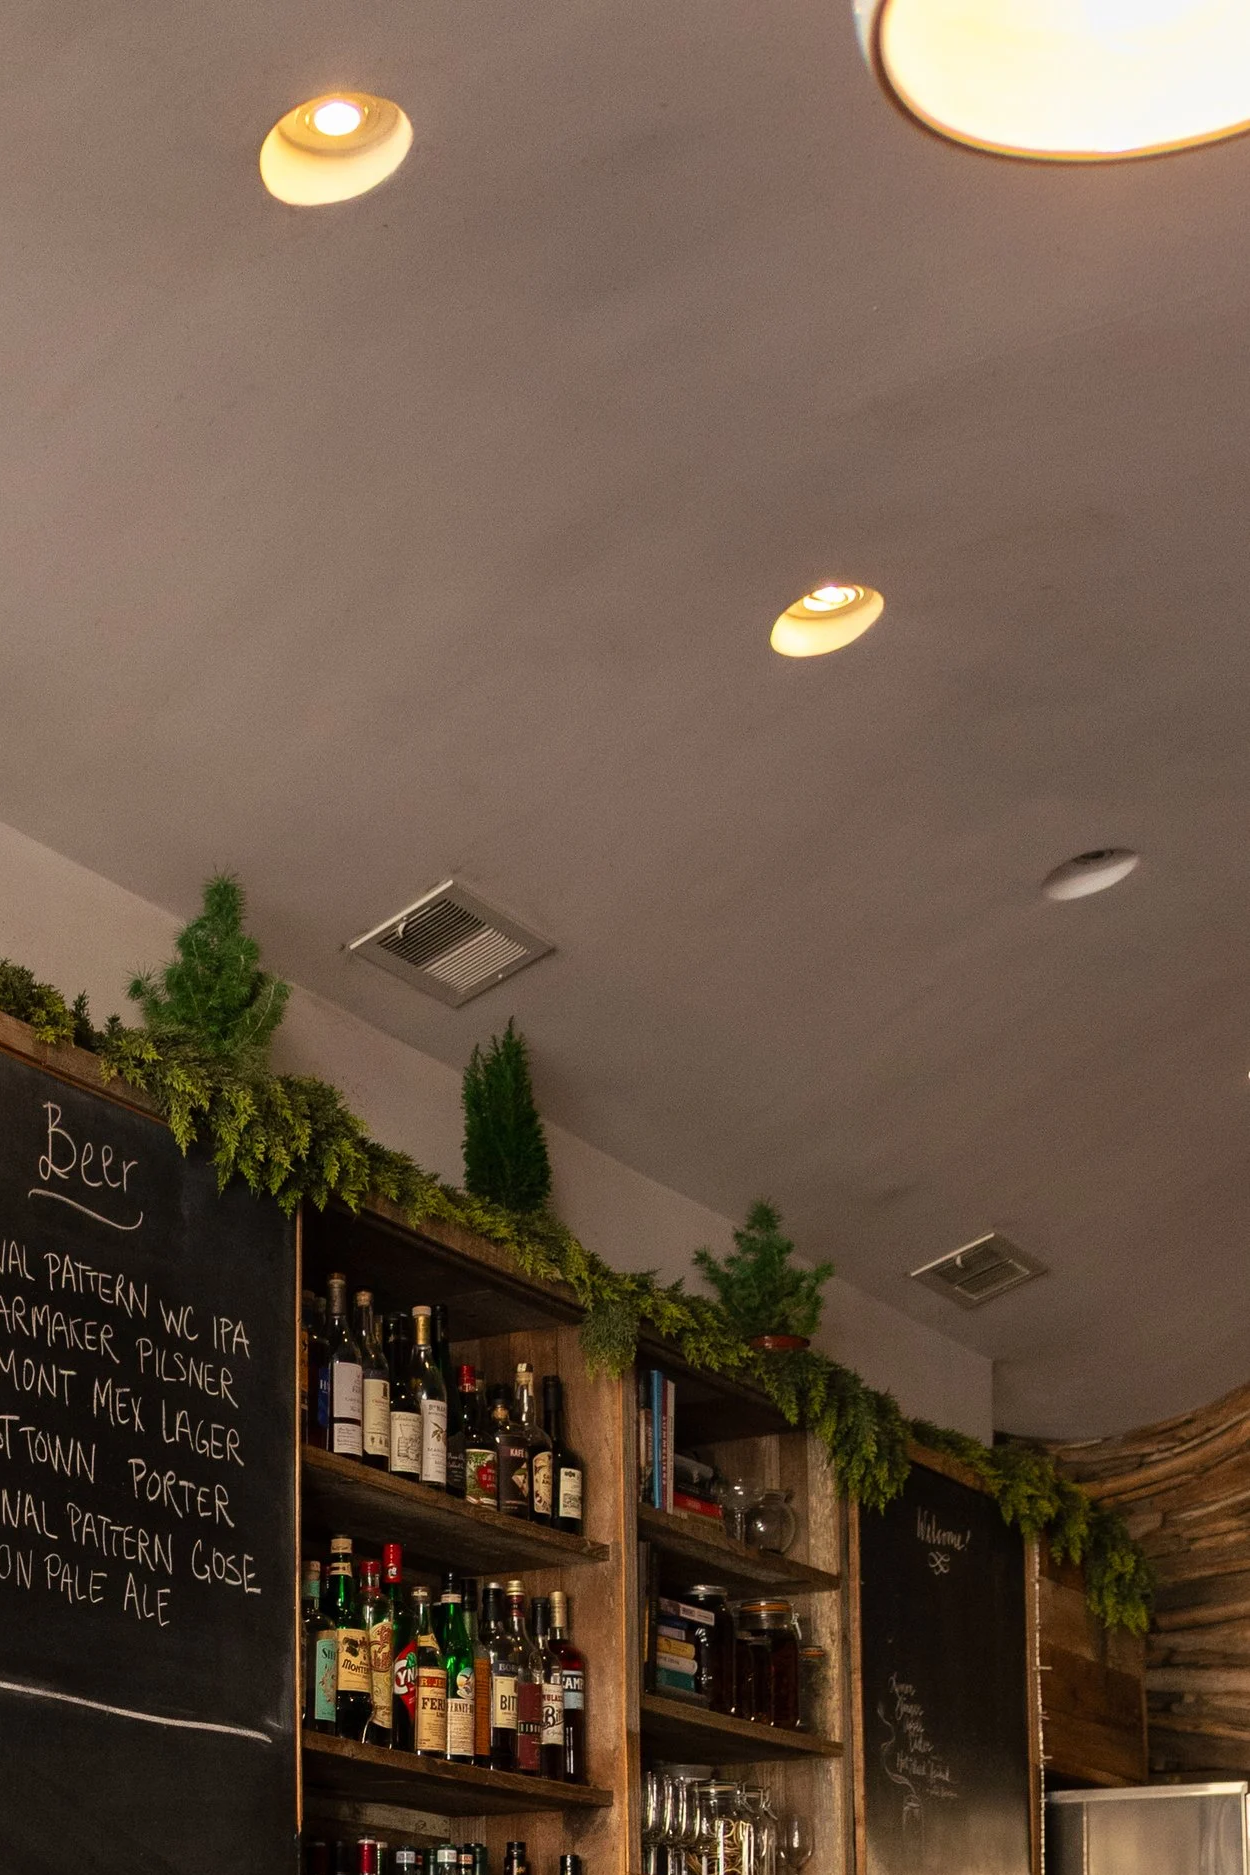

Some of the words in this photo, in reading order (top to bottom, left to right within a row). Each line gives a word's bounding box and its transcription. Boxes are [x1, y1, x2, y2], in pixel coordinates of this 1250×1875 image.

[38, 1101, 138, 1192] Beer
[44, 1252, 147, 1319] PATTERN
[160, 1300, 199, 1341] WC
[213, 1316, 251, 1358] IPA
[136, 1337, 238, 1408] PILSNER
[93, 1377, 145, 1432] MEX
[162, 1400, 244, 1466] LAGER
[128, 1458, 234, 1528] PORTER
[44, 1553, 108, 1605] PALE
[123, 1572, 171, 1627] ALE
[67, 1502, 173, 1575] PATTERN
[191, 1540, 262, 1594] GOSE
